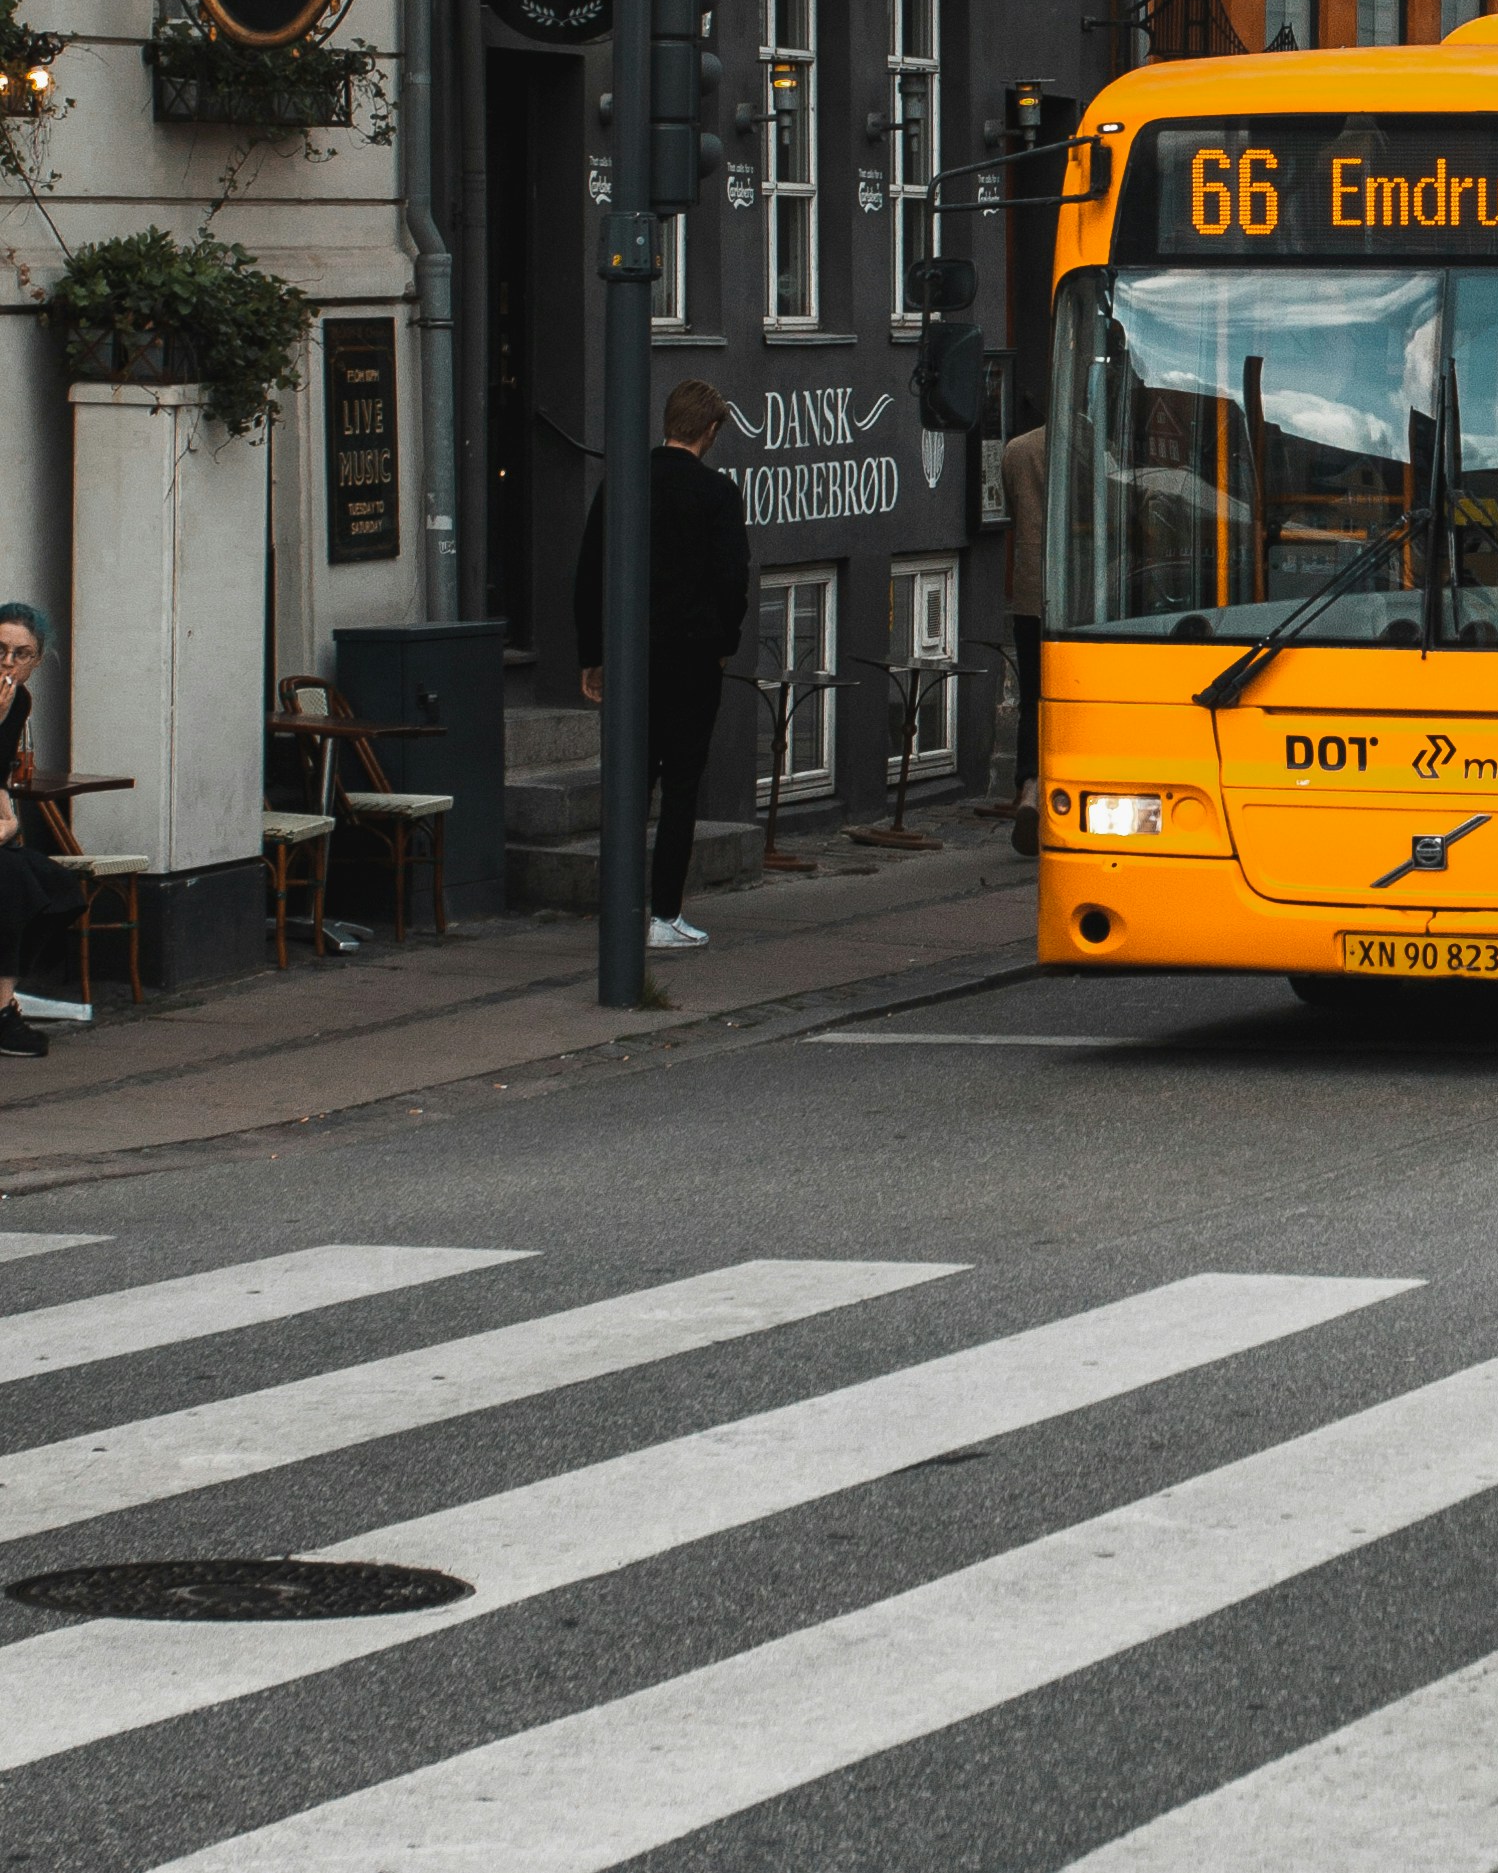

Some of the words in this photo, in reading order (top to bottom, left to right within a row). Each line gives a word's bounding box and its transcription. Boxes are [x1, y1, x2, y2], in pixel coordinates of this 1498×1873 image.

[1191, 148, 1278, 235] 66
[342, 399, 384, 435] LIVE
[764, 387, 854, 450] DANSK
[339, 447, 392, 487] MUSIC
[717, 456, 899, 527] MØRREBRØD
[1286, 735, 1379, 772] DOT
[1358, 940, 1396, 968] XN
[1404, 942, 1439, 970] 90
